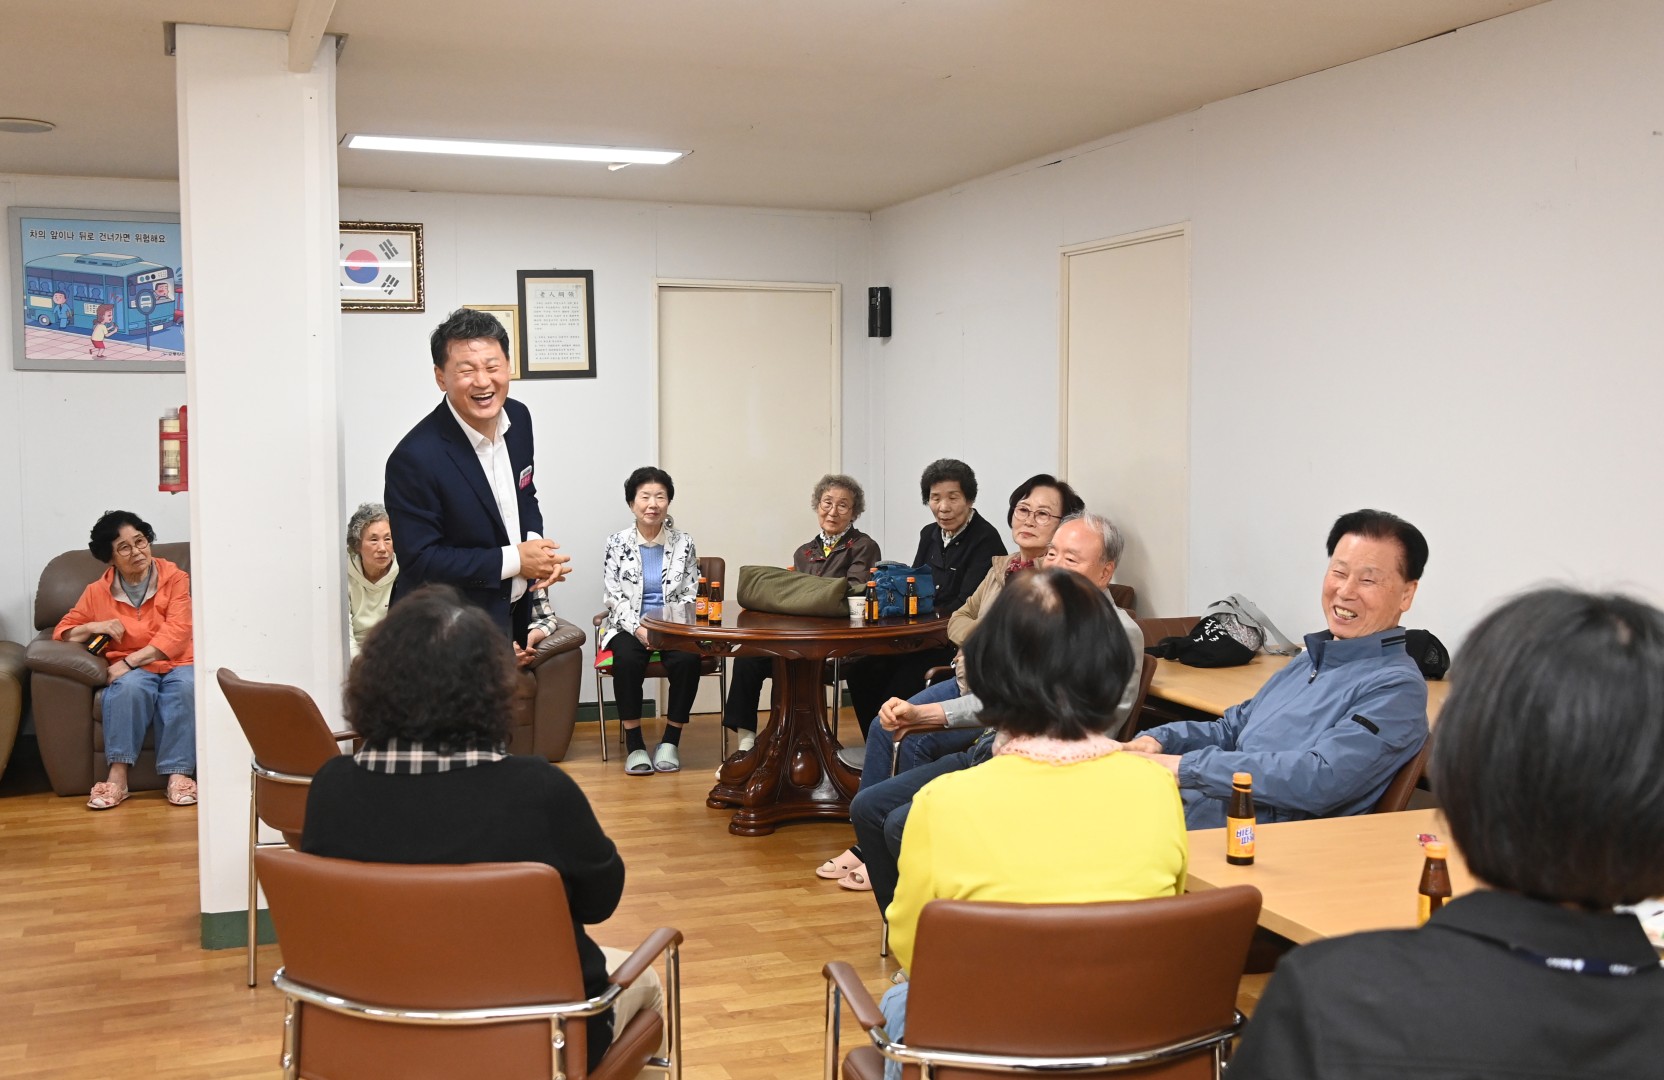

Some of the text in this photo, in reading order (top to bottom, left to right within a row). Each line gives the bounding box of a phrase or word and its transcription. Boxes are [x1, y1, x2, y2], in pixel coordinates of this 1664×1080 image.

[29, 229, 166, 243] 차의 앞이나 뒤로 건너가면 위험해요
